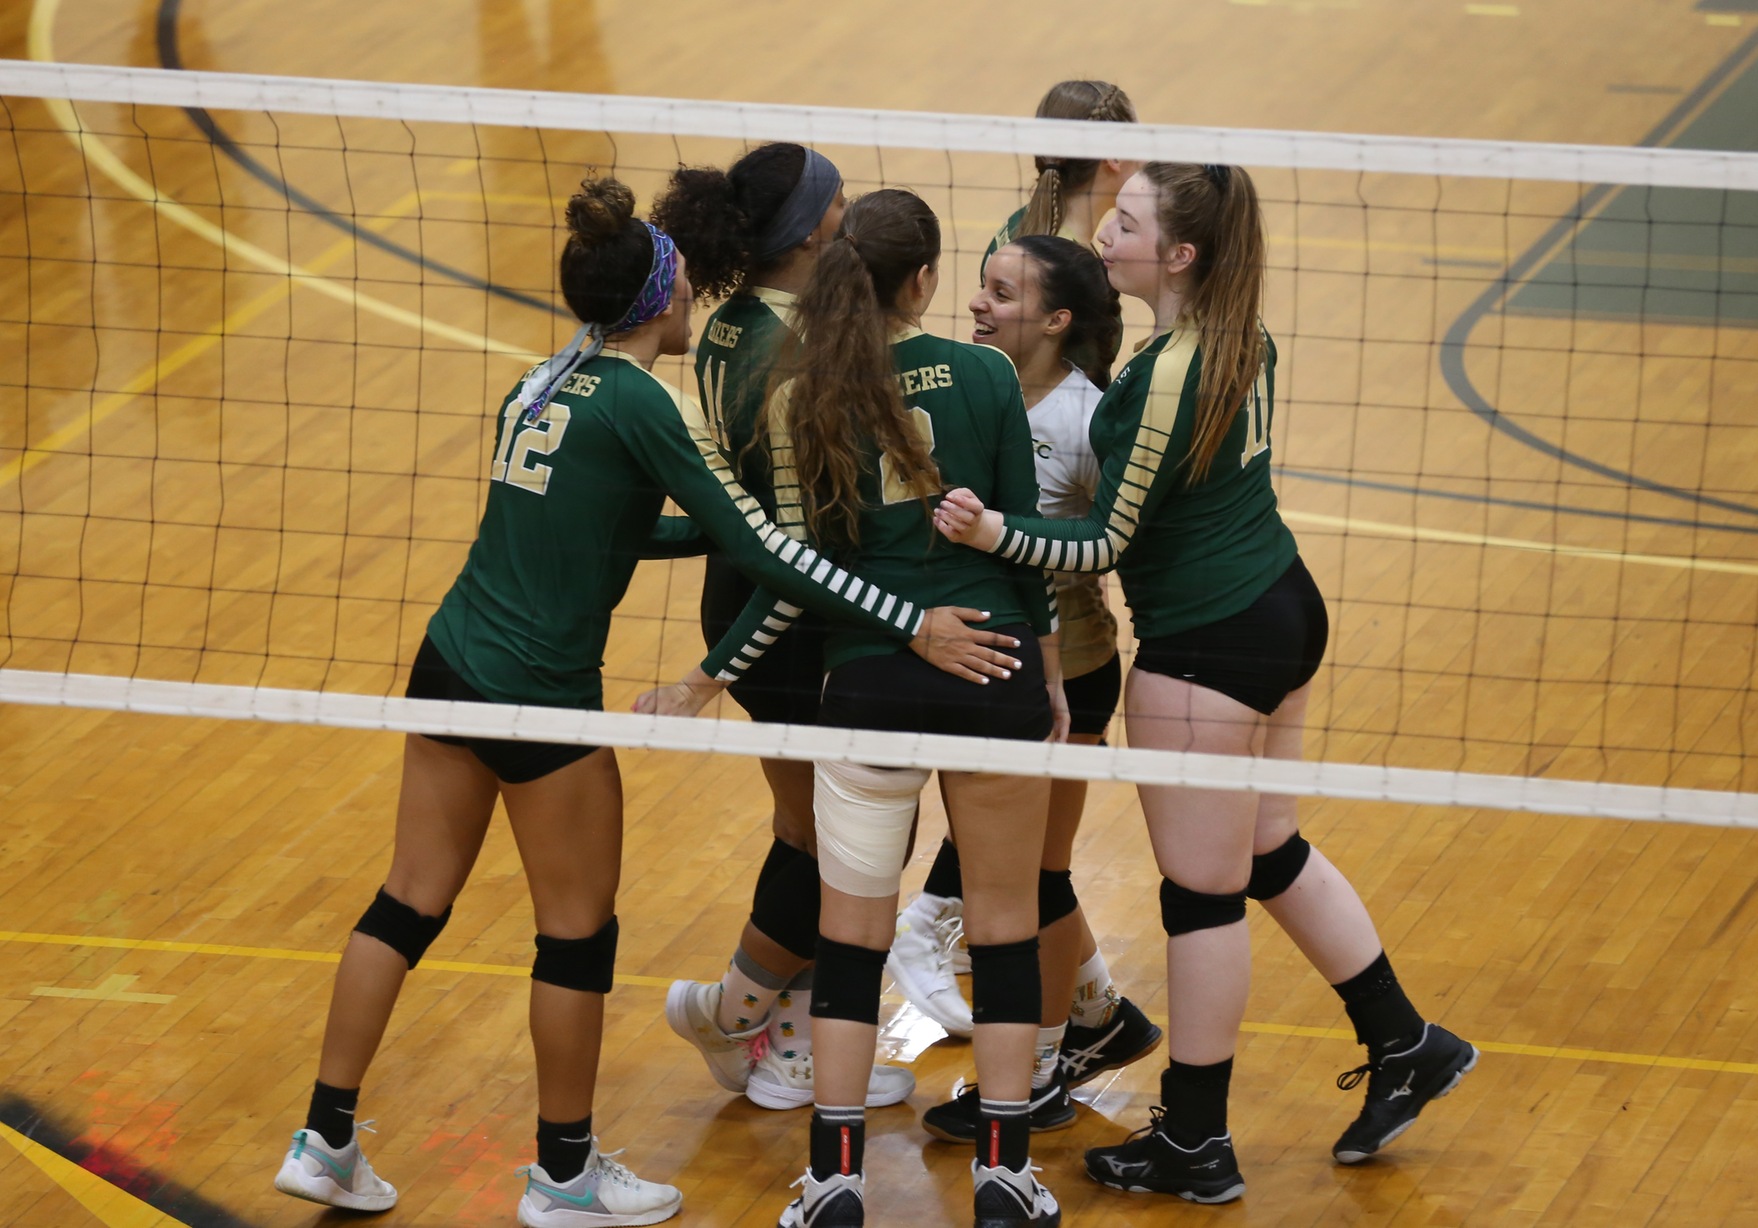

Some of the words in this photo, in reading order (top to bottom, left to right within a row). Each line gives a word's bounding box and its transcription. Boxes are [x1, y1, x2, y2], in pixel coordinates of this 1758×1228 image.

[520, 364, 602, 398] BERS
[894, 363, 953, 397] ERS
[491, 398, 572, 496] 12
